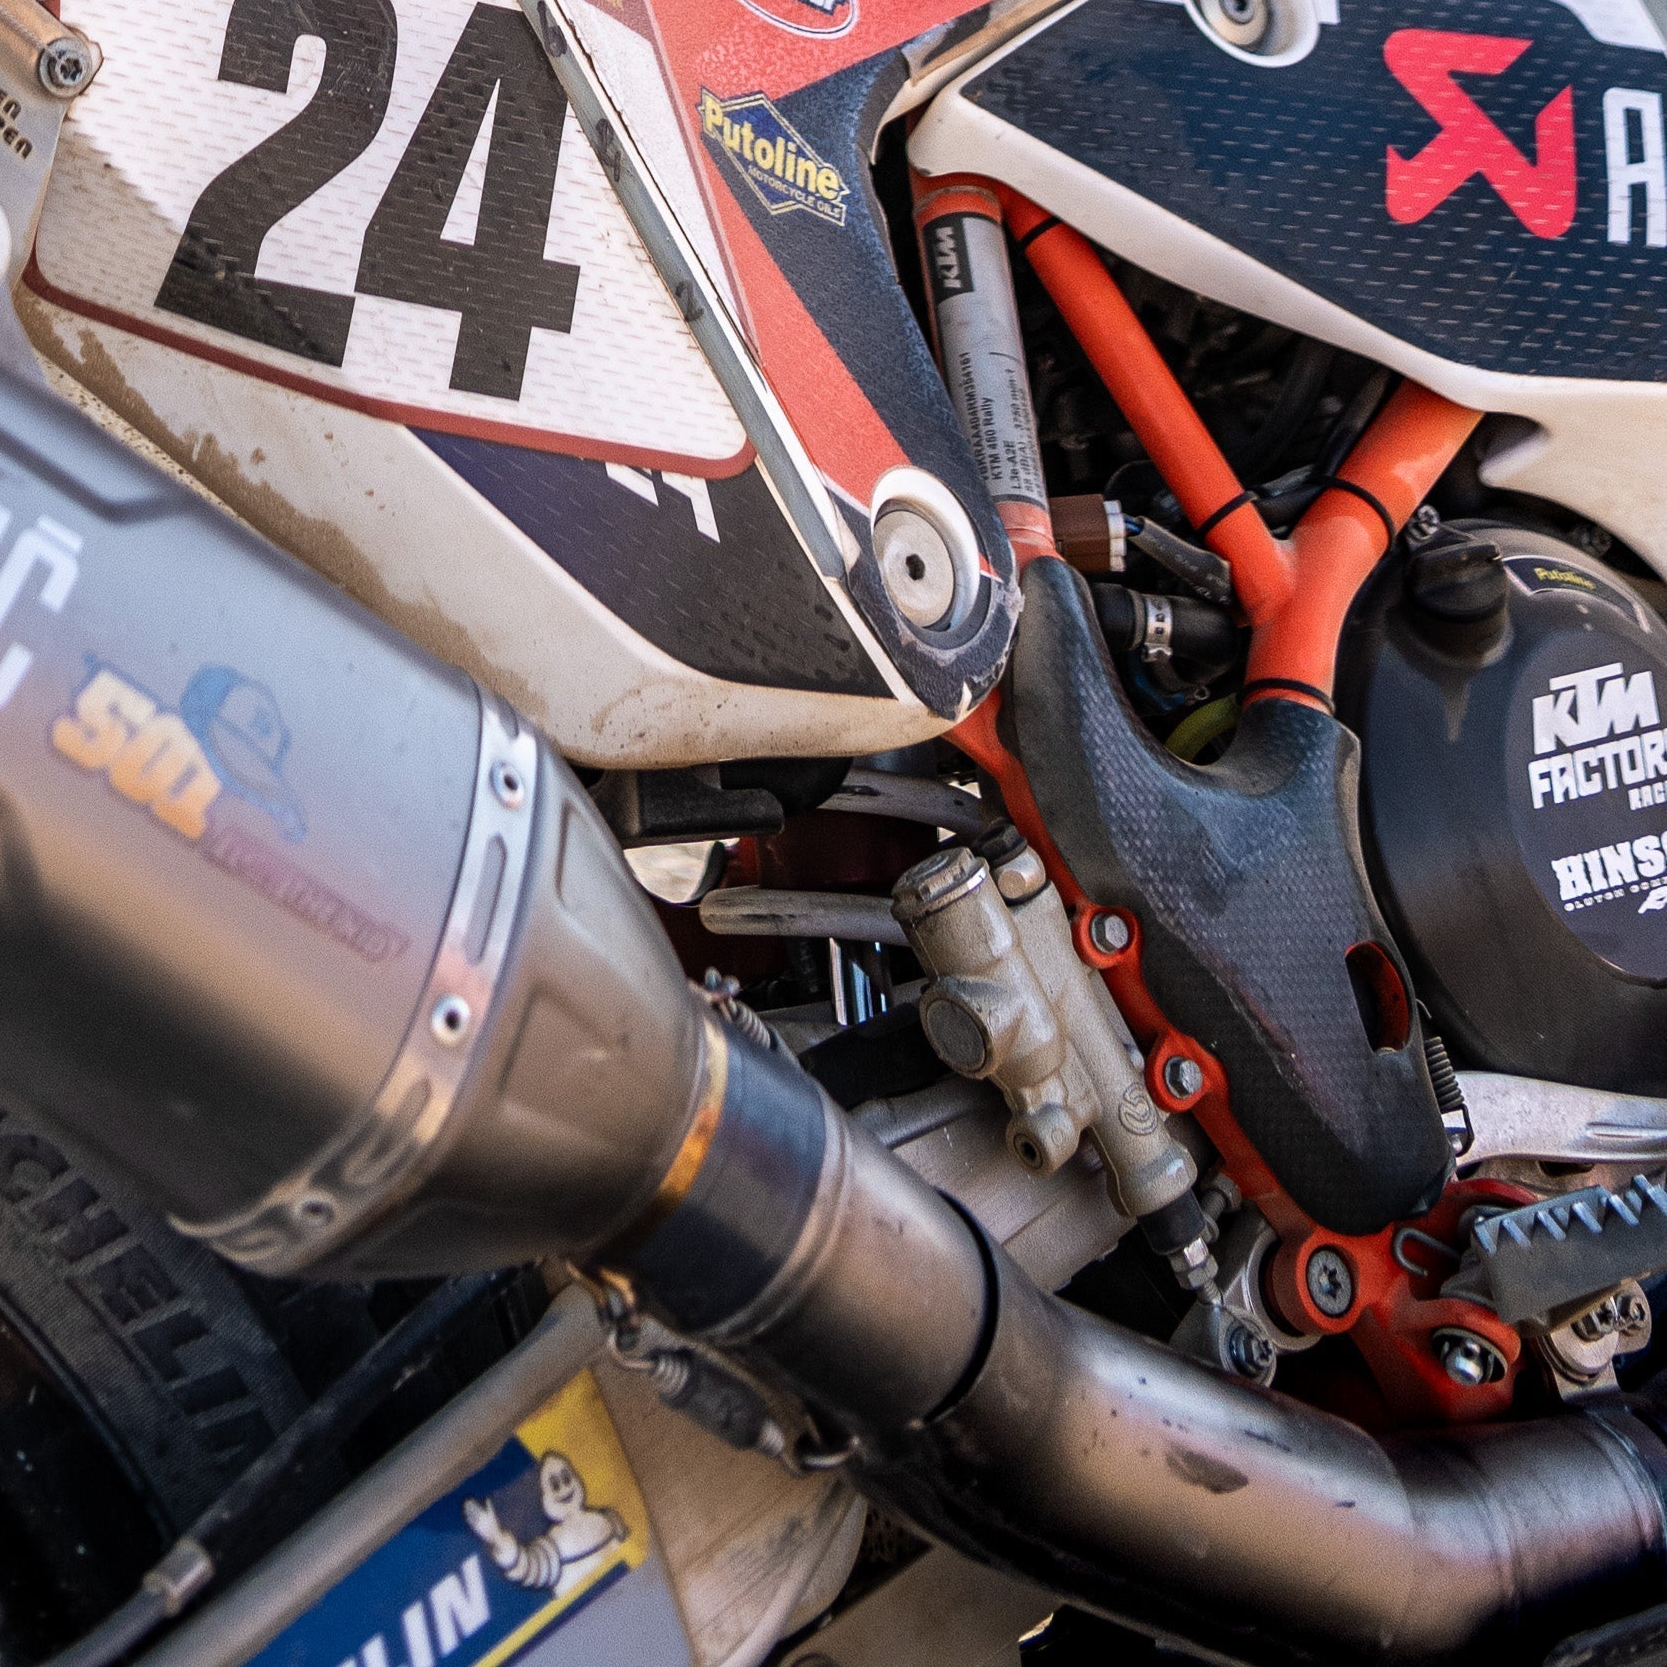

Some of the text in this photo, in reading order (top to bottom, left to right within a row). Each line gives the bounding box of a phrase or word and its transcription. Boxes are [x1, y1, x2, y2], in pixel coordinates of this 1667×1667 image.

[705, 94, 840, 200] Putoline
[747, 164, 817, 208] MOTORCYCLE
[935, 226, 963, 289] KTM
[674, 280, 704, 323] 2
[980, 396, 995, 427] Rally
[1532, 662, 1660, 755] KTM
[1528, 726, 1667, 810] FACTOR
[1551, 830, 1667, 902] HINS
